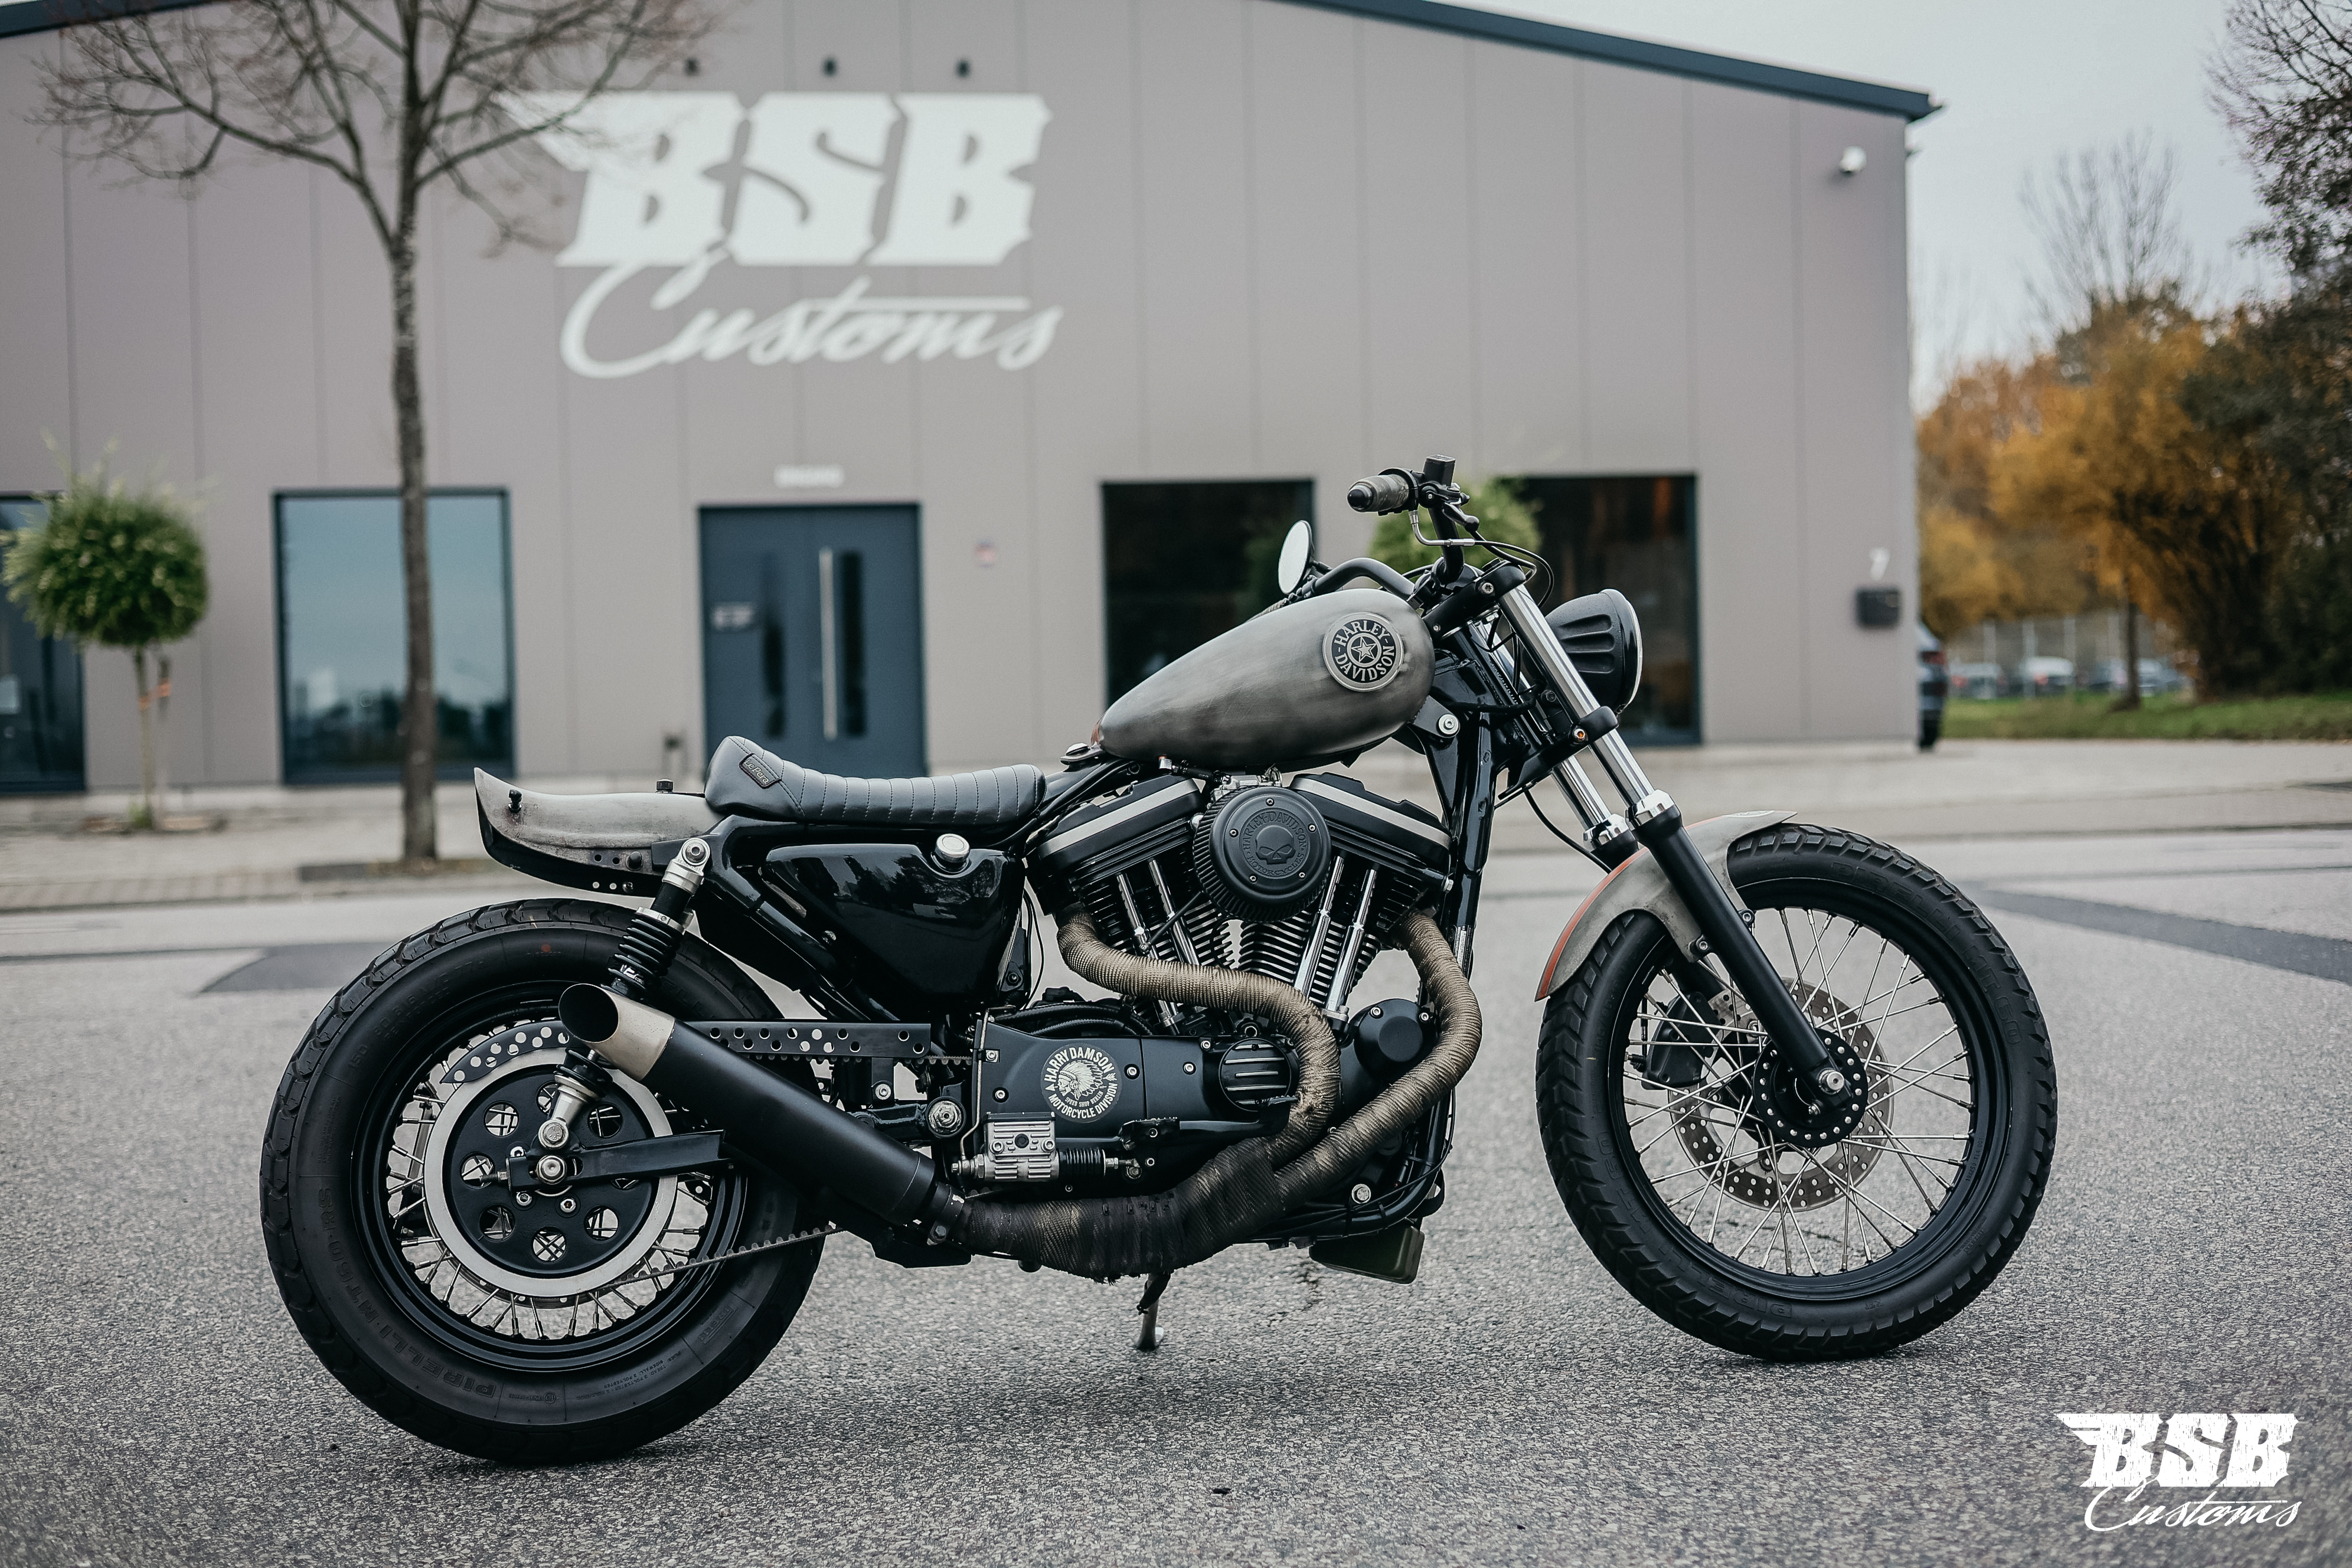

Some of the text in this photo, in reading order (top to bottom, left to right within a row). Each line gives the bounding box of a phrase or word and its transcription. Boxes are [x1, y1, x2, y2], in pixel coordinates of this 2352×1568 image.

[494, 90, 1052, 267] BSB
[560, 241, 1064, 380] Customs
[744, 759, 769, 784] Le Pera
[1247, 852, 1304, 876] MOTORCYCLES
[1044, 1047, 1115, 1082] HARRY DAMSON
[1048, 1083, 1118, 1119] MOTORCYCLE DIVISION
[1064, 1097, 1077, 1106] SPEED
[1090, 1090, 1104, 1105] BERLIN
